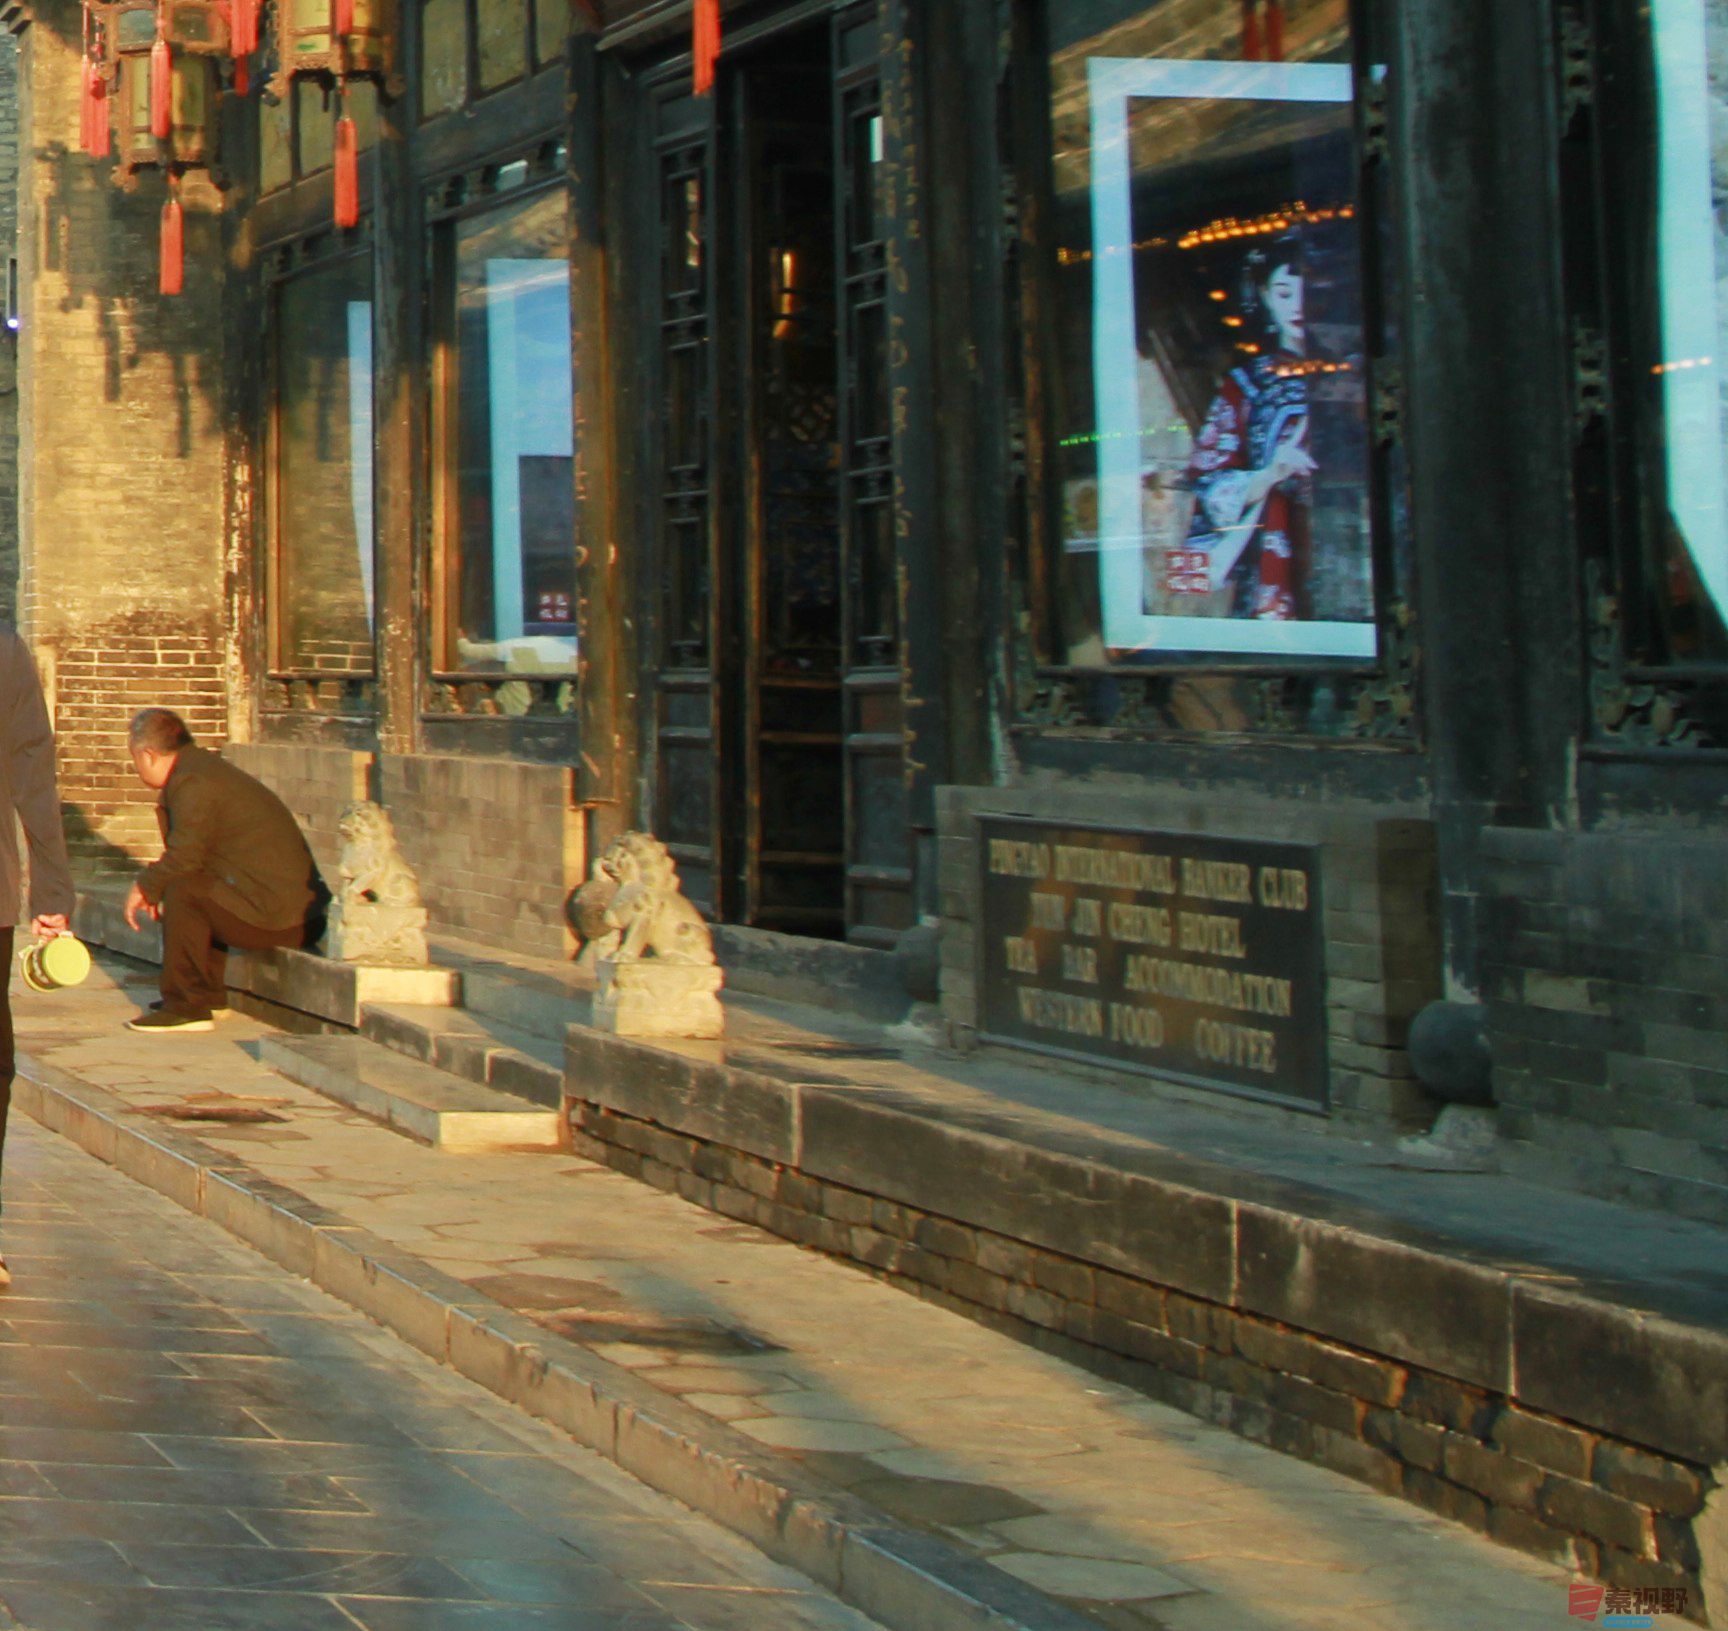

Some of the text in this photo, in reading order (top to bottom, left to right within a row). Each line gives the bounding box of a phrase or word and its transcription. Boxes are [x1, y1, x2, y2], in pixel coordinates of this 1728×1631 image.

[1053, 844, 1176, 894] INTERNATIONAL
[1258, 865, 1307, 911] CLUB
[1178, 910, 1246, 959] HOTEL
[1109, 1002, 1164, 1048] FOOD
[1196, 1017, 1276, 1073] COFFEE
